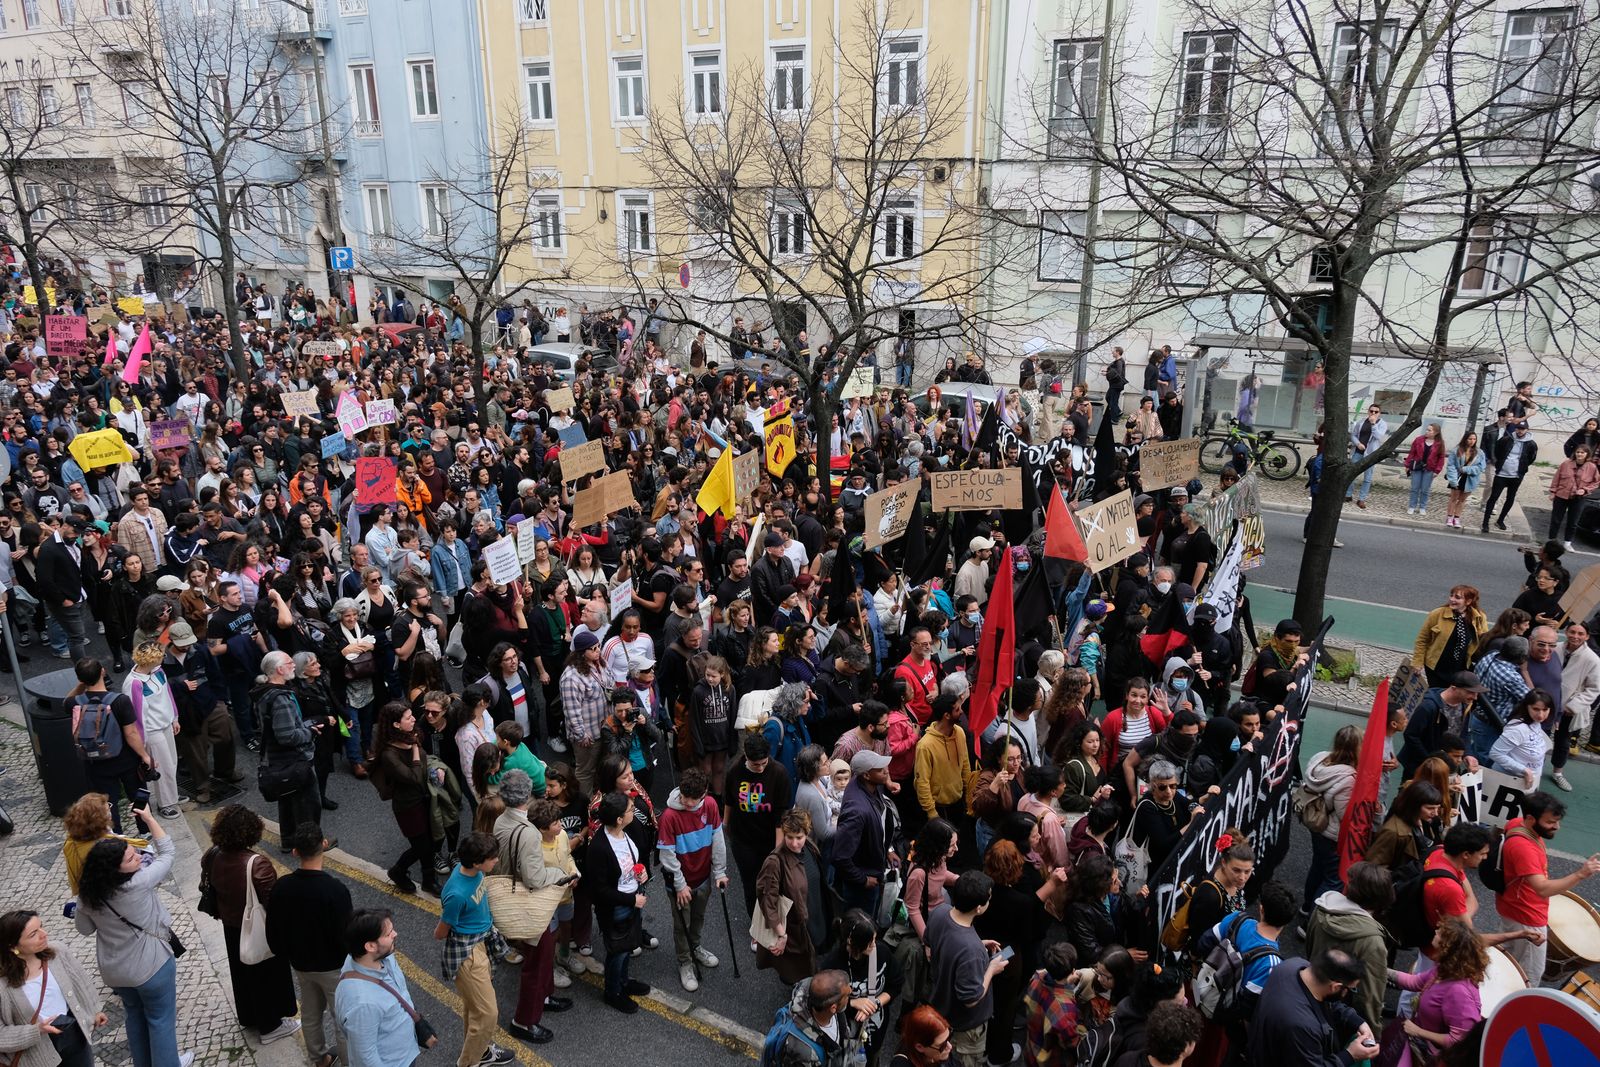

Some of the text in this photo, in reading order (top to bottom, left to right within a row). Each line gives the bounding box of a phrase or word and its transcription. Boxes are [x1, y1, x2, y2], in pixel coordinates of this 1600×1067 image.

[335, 249, 348, 268] P
[1163, 453, 1180, 462] LOCAL
[1165, 474, 1183, 483] LOCAL
[880, 495, 893, 508] POR
[881, 500, 906, 517] DESPEJO
[1105, 496, 1135, 526] MATEM
[888, 514, 898, 525] MIL
[1095, 532, 1126, 561] O AL
